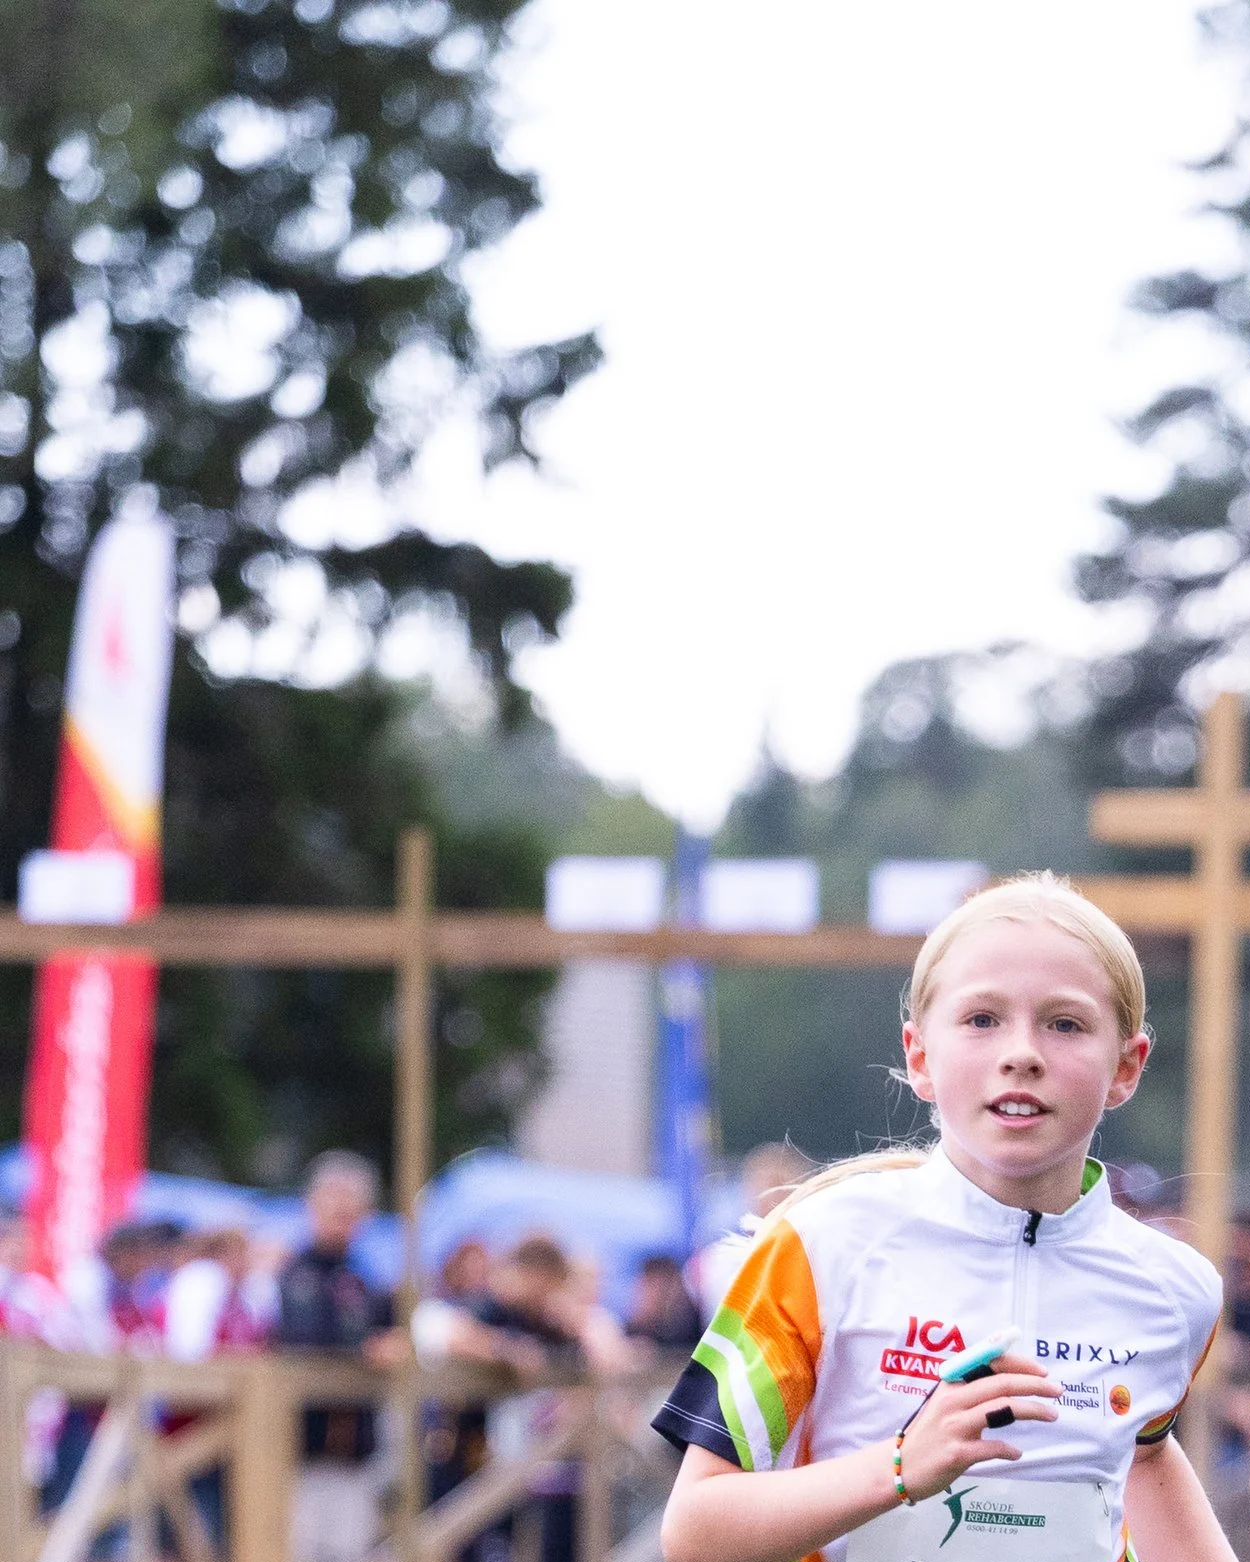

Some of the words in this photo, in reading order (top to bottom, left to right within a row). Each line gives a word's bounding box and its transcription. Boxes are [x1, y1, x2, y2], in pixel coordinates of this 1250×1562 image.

[904, 1315, 966, 1353] ICA
[1036, 1339, 1139, 1366] BRIXLY
[884, 1380, 929, 1397] Lerums
[968, 1500, 1015, 1513] SKÖVDE
[966, 1511, 1045, 1526] REHABCENTER
